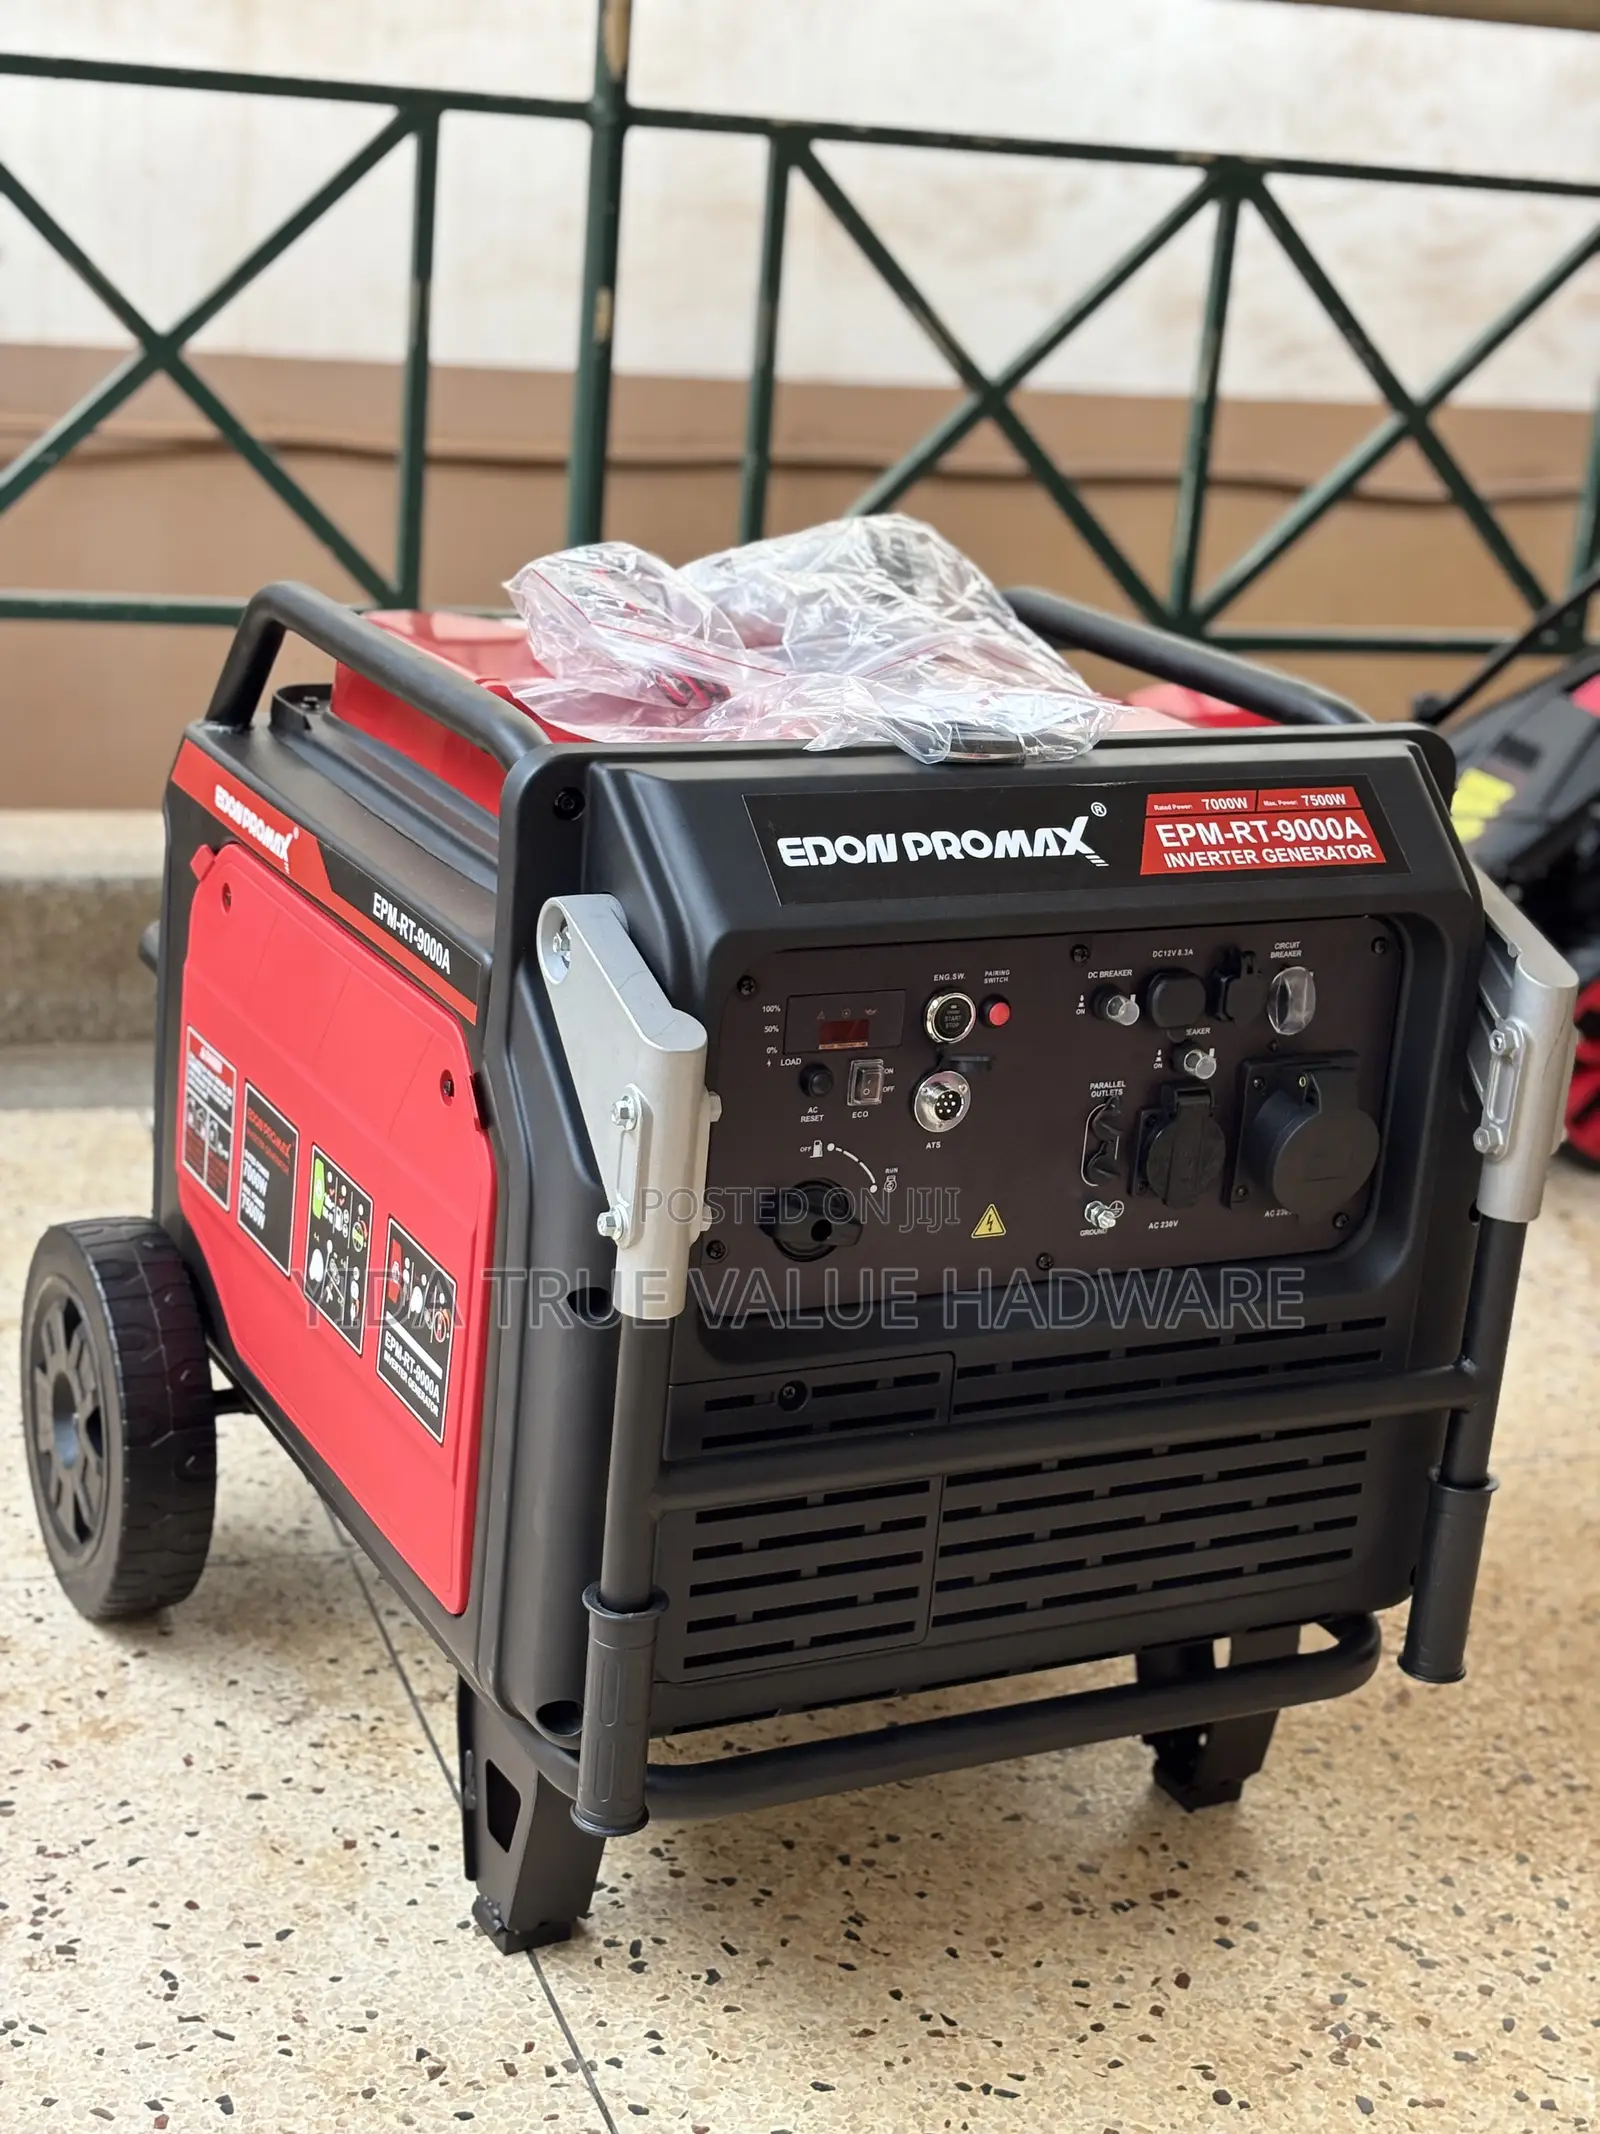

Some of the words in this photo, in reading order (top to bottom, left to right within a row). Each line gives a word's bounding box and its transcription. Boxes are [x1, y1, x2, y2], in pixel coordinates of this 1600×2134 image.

[1201, 797, 1248, 811] 7000W
[1301, 794, 1347, 807] 7500W
[1155, 816, 1368, 848] EPM-RT-9000A
[777, 833, 898, 867] EDON
[902, 816, 1109, 867] PROMAX
[1163, 849, 1260, 869] INVERTER
[1262, 844, 1376, 864] GENERATOR
[372, 892, 450, 975] EPM-RT-9000A
[1274, 941, 1300, 950] CIRCUIT
[1152, 950, 1177, 958] DC12V
[1177, 948, 1194, 956] 8.3A
[1270, 949, 1302, 959] BREAKER
[984, 969, 1010, 977] PAIRING
[1088, 971, 1099, 979] DC
[1099, 969, 1133, 978] BREAKER
[762, 1005, 781, 1013] 100%
[764, 1025, 779, 1033] 50%
[766, 1046, 778, 1054] 0%
[780, 1057, 802, 1067] LOAD
[884, 1067, 894, 1075] ON
[882, 1085, 895, 1093] OFF
[1090, 1080, 1126, 1090] PARALLEL
[1091, 1088, 1123, 1098] OUTLETS
[807, 1106, 818, 1114] AC
[852, 1110, 869, 1119] ECO
[800, 1114, 824, 1123] RESET
[800, 1145, 812, 1153] OFF
[926, 1141, 941, 1149] ATS
[1264, 1209, 1275, 1218] AC
[1148, 1222, 1160, 1230] AC
[1160, 1219, 1179, 1228] 230V
[1080, 1227, 1108, 1237] GROUND
[385, 1330, 440, 1404] EPM-RT-9000A
[383, 1350, 408, 1384] INVERTER
[407, 1376, 440, 1418] GENERATOR
